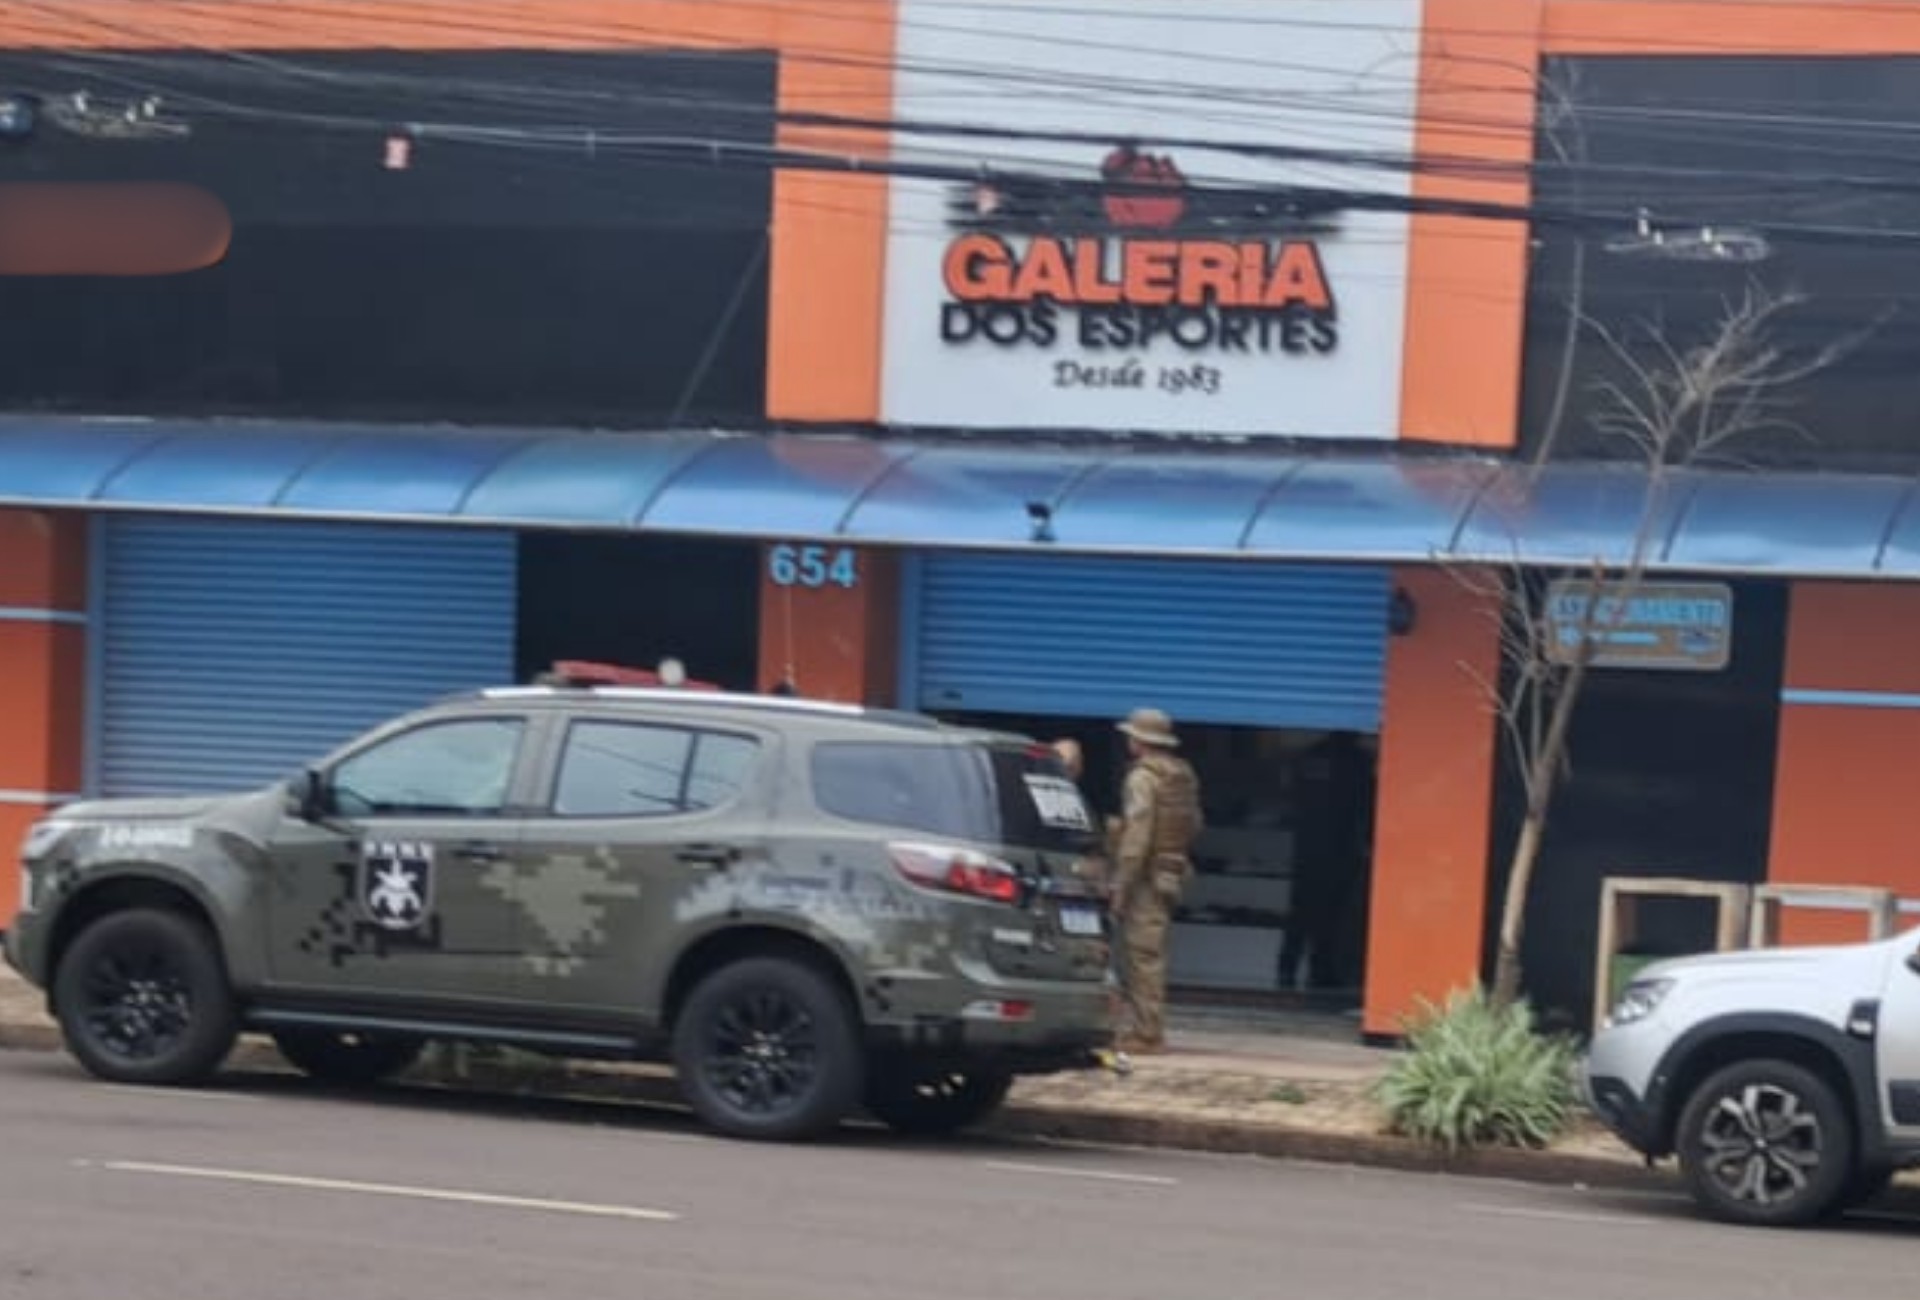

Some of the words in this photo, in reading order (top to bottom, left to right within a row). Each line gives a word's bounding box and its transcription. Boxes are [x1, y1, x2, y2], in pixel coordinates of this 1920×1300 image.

[941, 232, 1333, 309] GALERIA
[940, 303, 1058, 347] DOS
[1078, 305, 1337, 354] ESPORTES
[1053, 358, 1146, 390] Desde
[1158, 363, 1222, 394] 1983
[770, 545, 856, 588] 654
